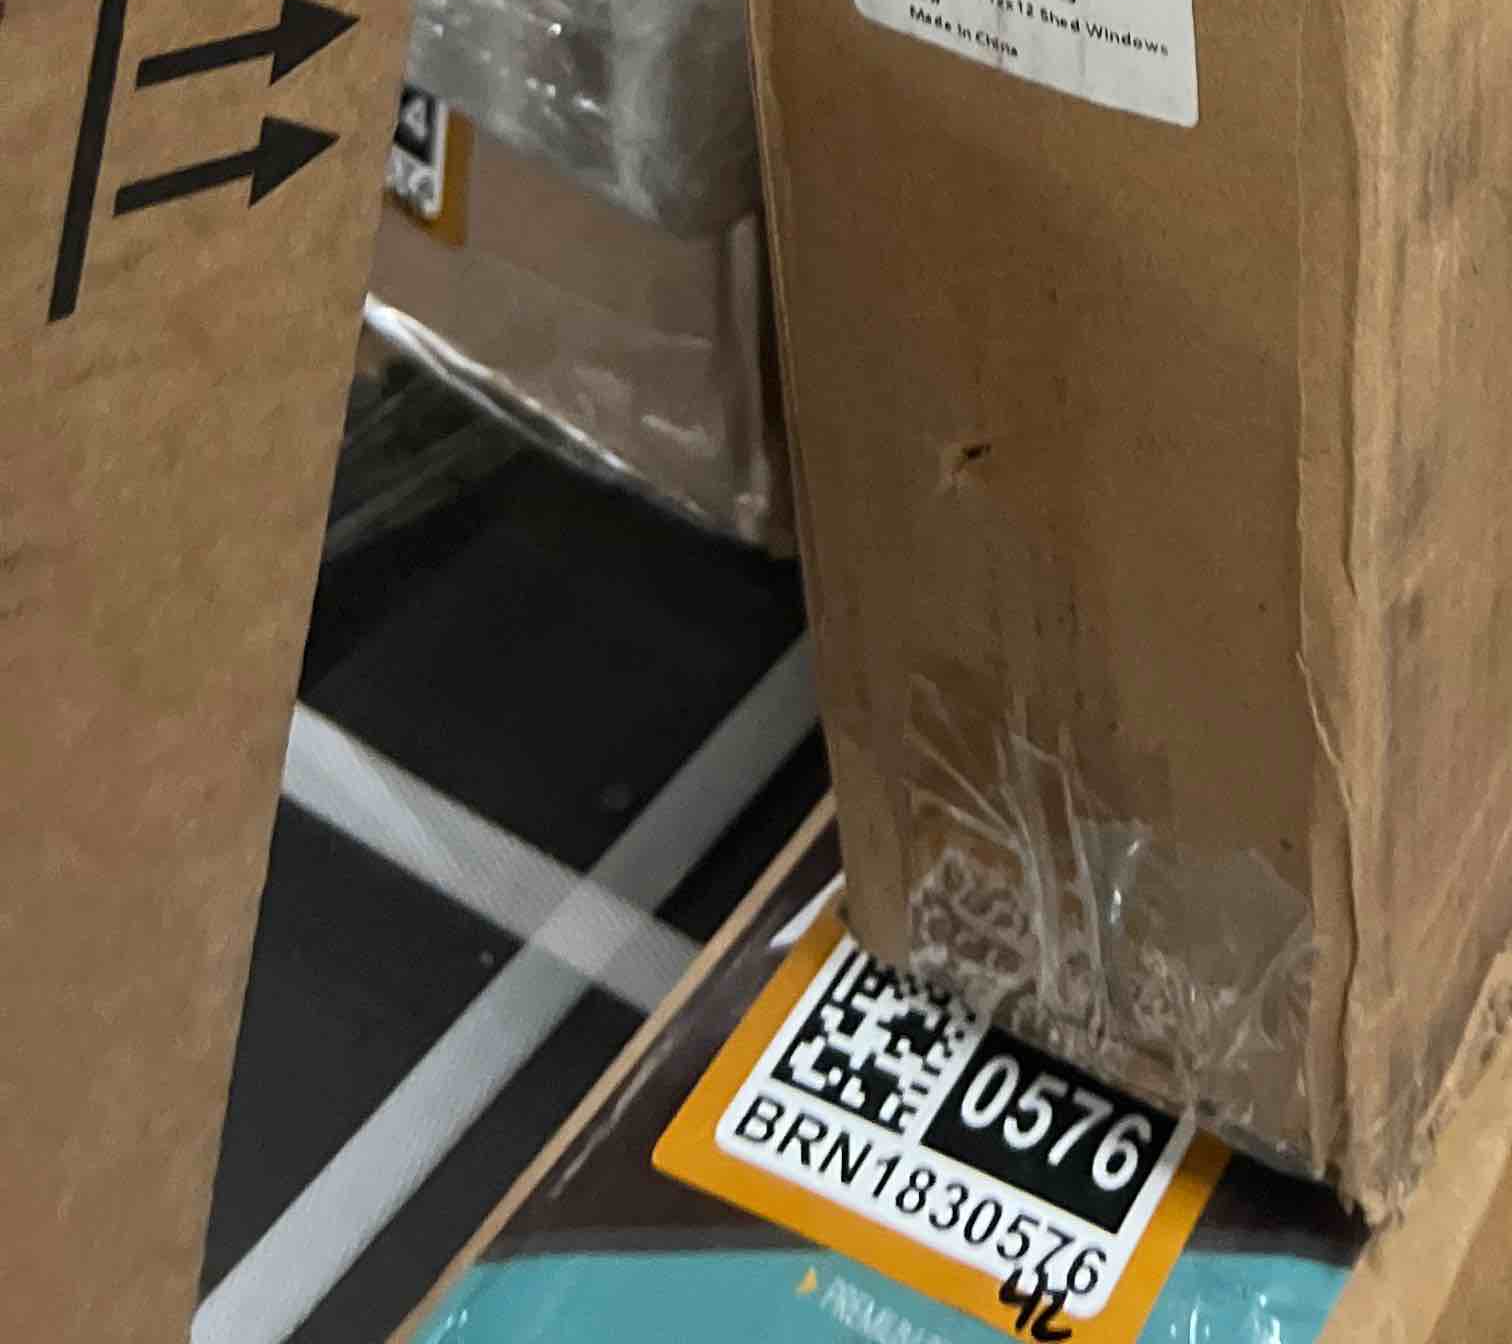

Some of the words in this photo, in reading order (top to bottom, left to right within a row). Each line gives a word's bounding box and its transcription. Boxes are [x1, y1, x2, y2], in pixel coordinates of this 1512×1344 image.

[910, 5, 952, 32] Made
[975, 31, 1018, 58] China
[1040, 8, 1080, 34] Shed
[1086, 21, 1169, 57] Windows
[959, 1054, 1153, 1192] 0576
[734, 1094, 1108, 1296] BRN1830576
